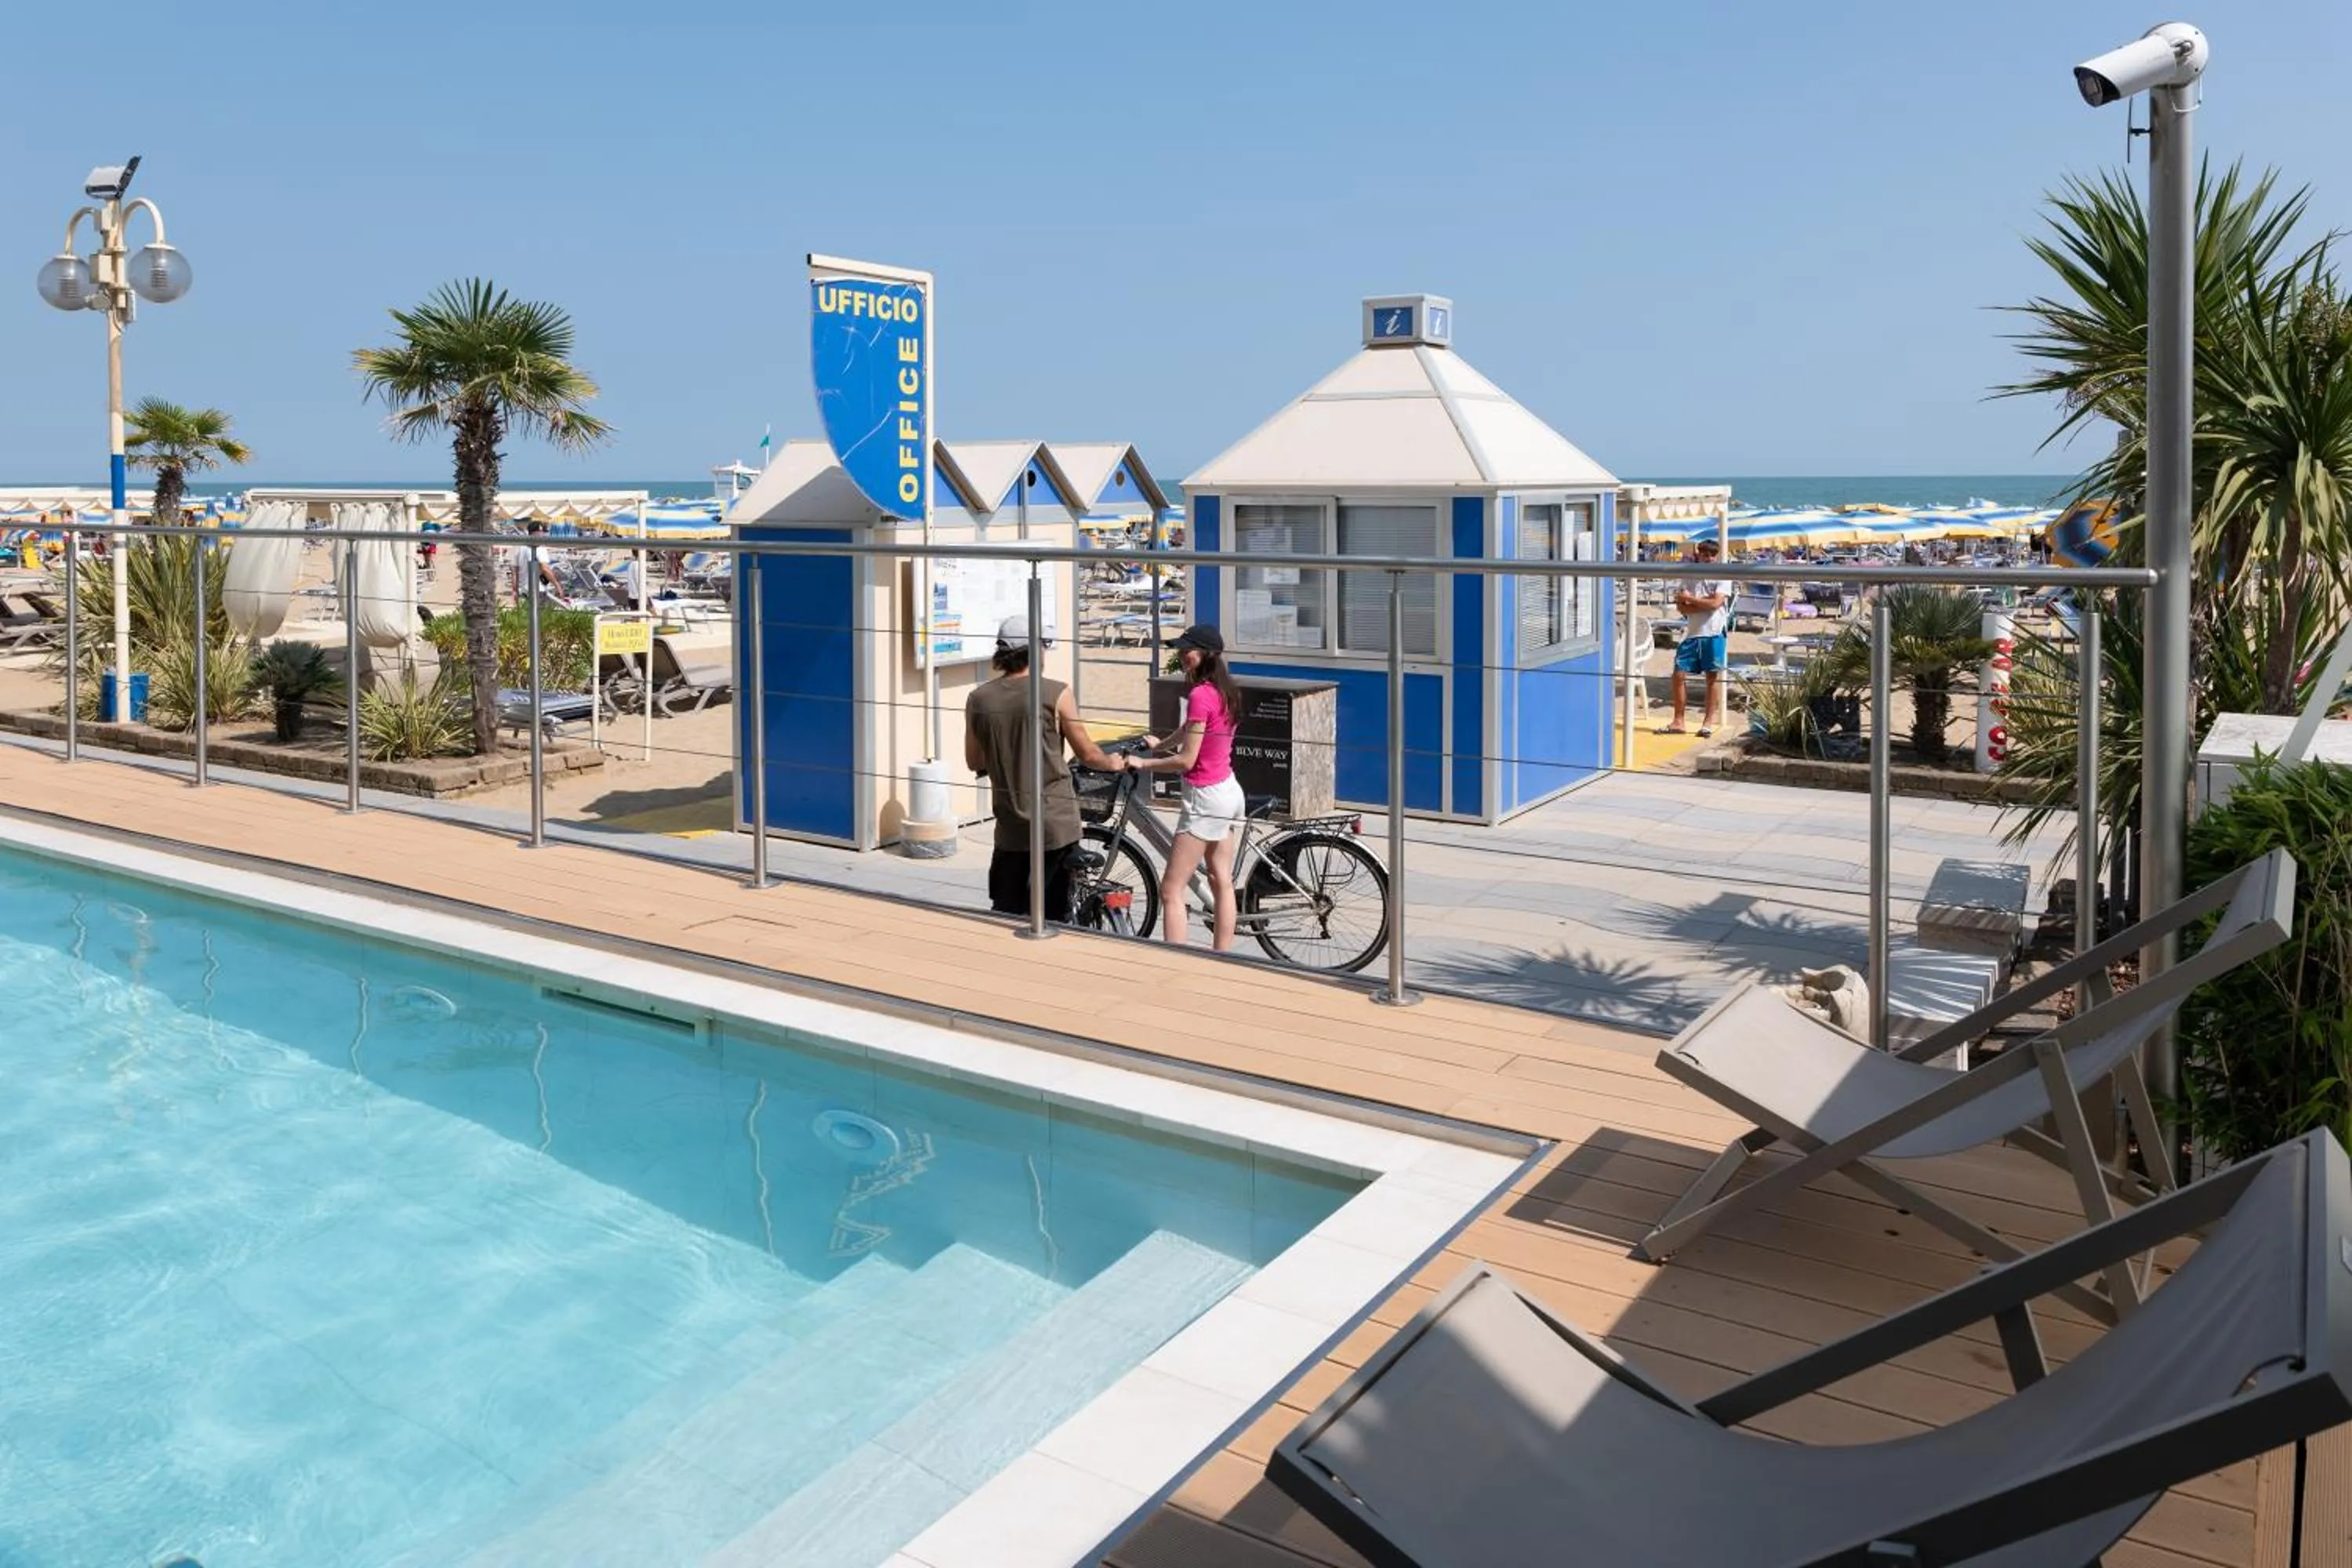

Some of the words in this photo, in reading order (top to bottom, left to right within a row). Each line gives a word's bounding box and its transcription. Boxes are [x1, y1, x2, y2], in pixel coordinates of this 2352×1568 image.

[818, 285, 919, 323] UFFICIO
[1385, 309, 1402, 335] i
[898, 337, 919, 503] OFFICE
